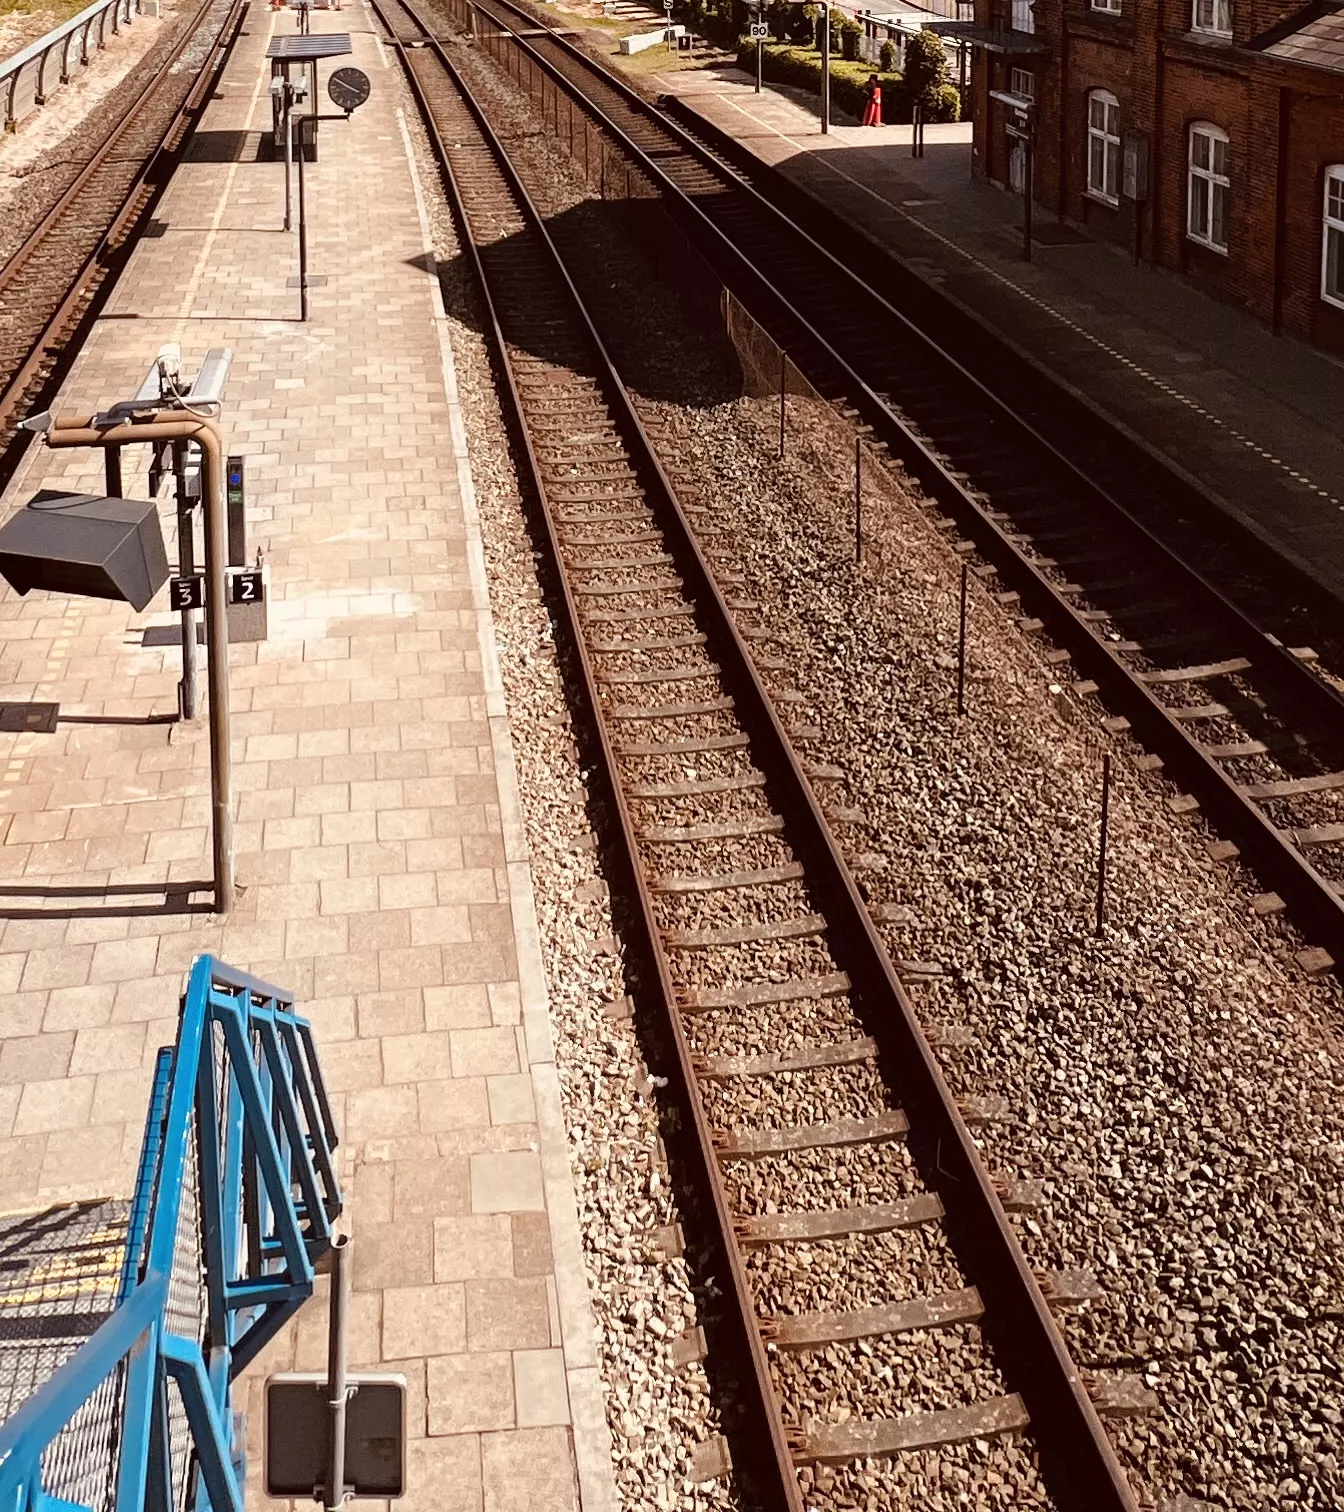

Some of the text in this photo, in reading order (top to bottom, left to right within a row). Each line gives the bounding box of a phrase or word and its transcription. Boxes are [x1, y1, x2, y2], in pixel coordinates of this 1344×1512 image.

[752, 26, 767, 36] 90
[179, 588, 193, 606] 3
[241, 582, 255, 599] 2
